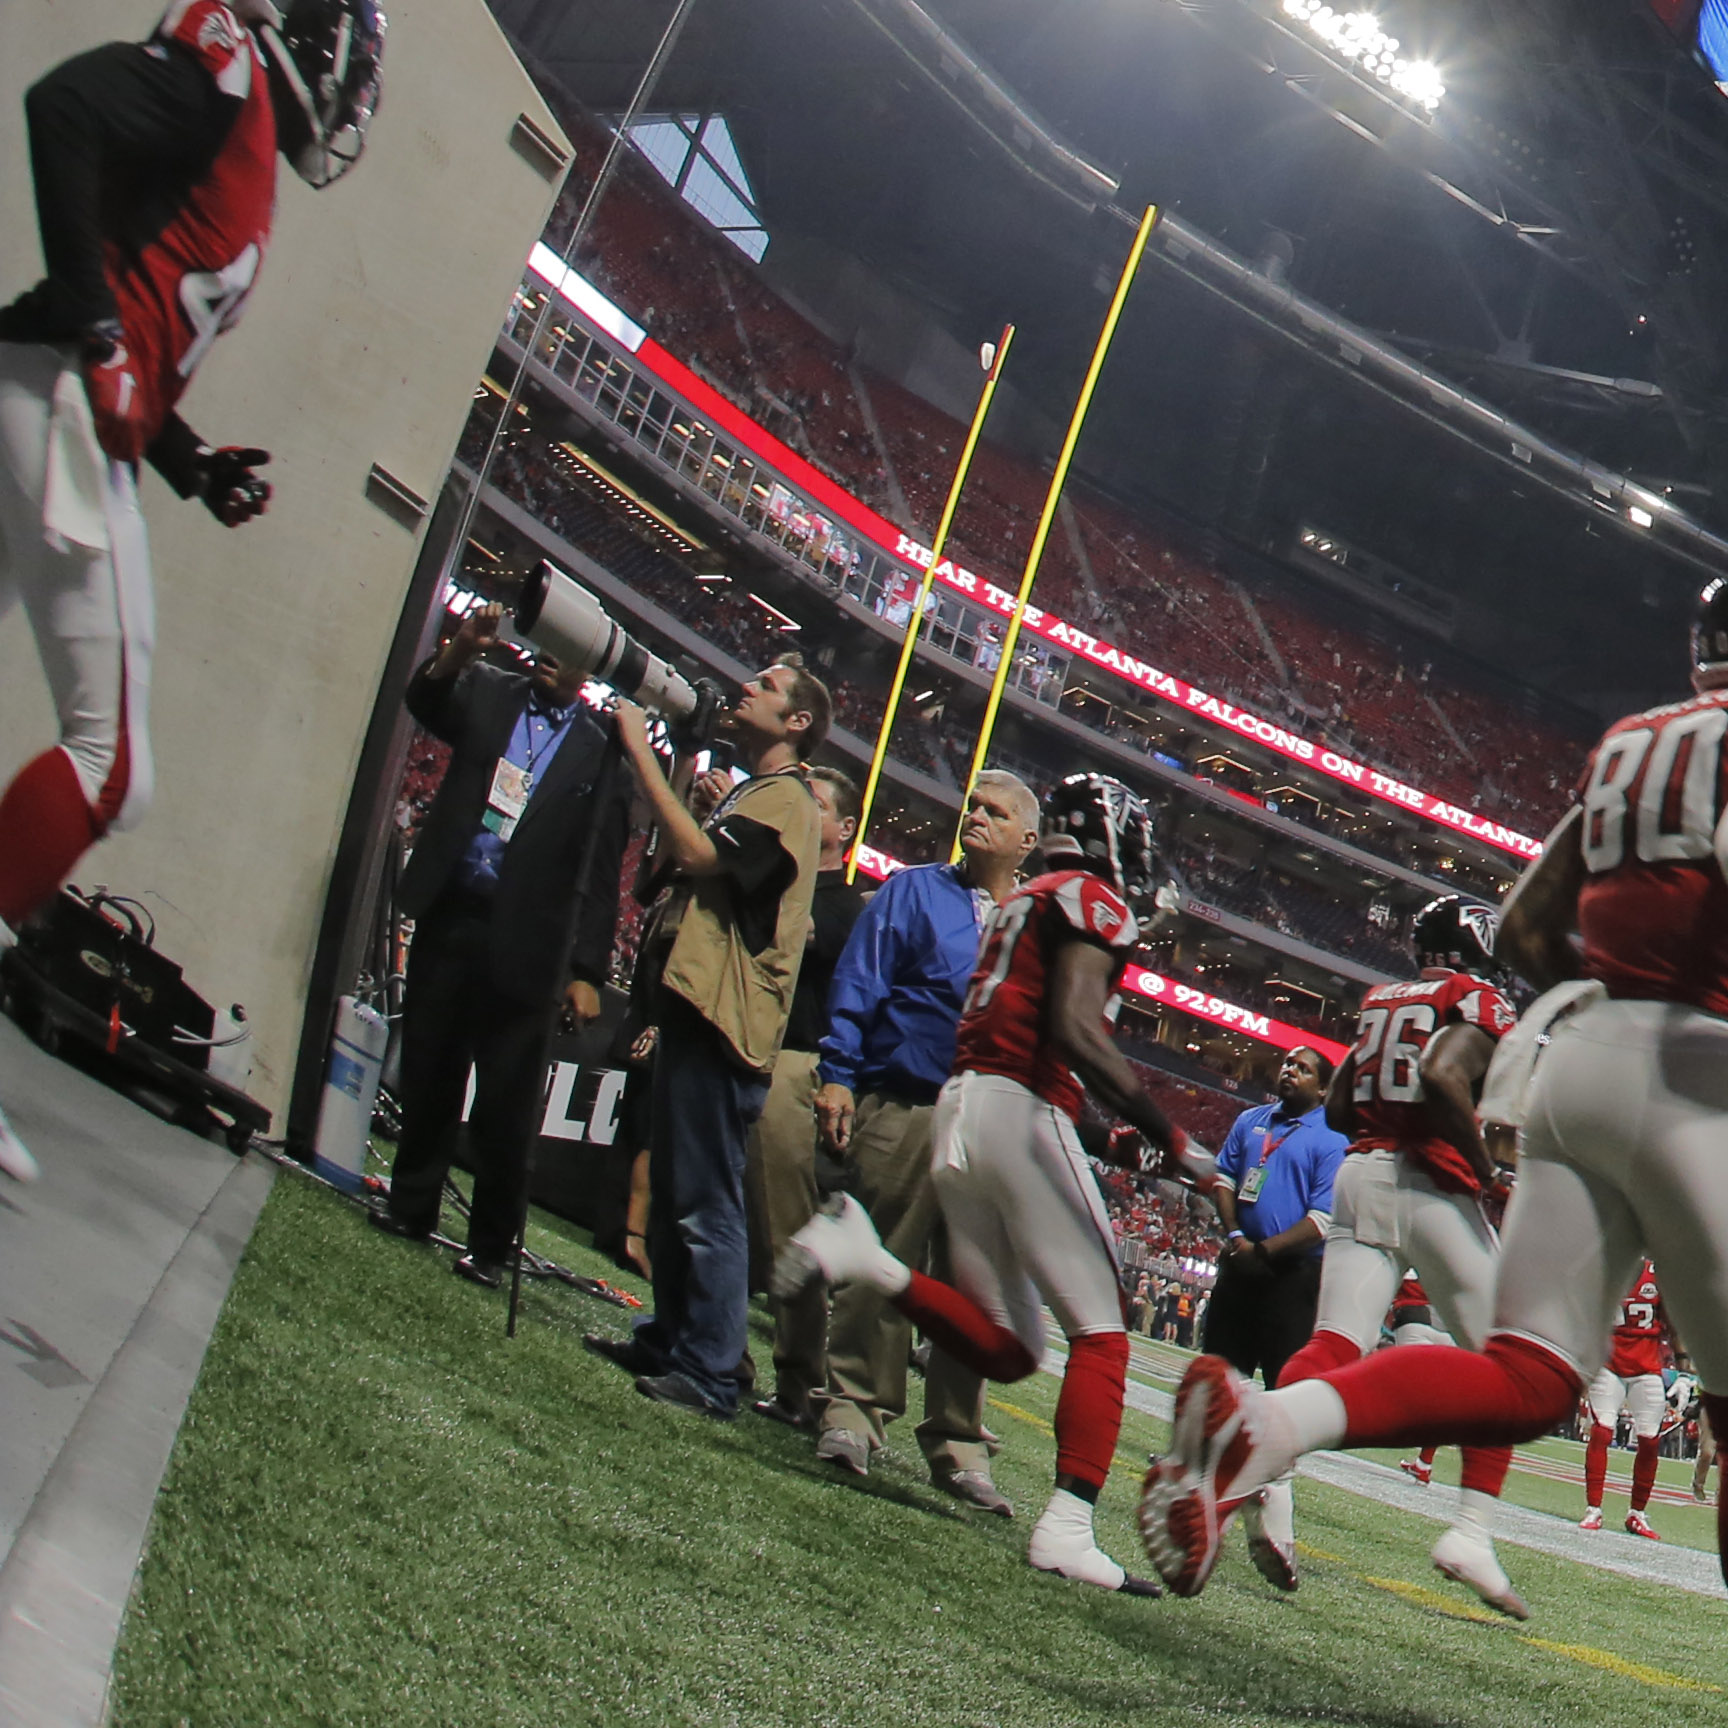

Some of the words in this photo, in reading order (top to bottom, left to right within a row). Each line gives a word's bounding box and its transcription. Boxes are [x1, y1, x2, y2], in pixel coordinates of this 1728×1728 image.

[897, 534, 977, 592] HEAR
[984, 583, 1044, 627] THE
[1048, 622, 1179, 698] ATLANTA
[1187, 687, 1314, 759] FALCONS
[1321, 752, 1364, 782] ON
[1370, 772, 1425, 808] THE
[1430, 802, 1544, 856] ATLANTA
[1138, 972, 1165, 996] @
[1174, 985, 1270, 1036] 92.9FM
[1353, 1004, 1435, 1103] 26
